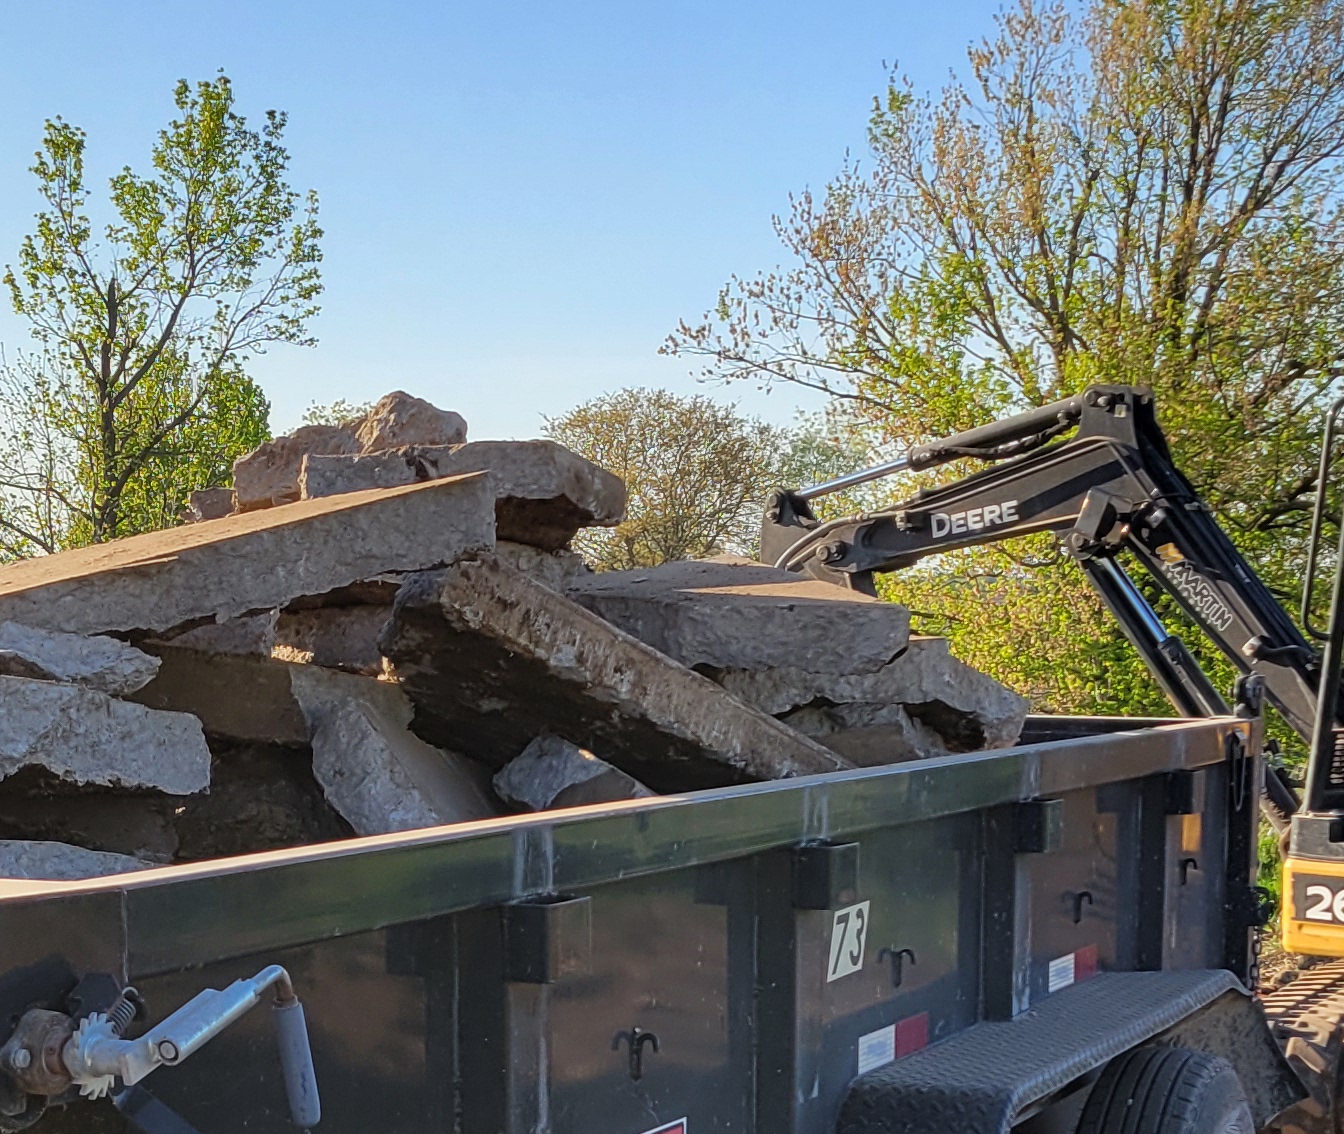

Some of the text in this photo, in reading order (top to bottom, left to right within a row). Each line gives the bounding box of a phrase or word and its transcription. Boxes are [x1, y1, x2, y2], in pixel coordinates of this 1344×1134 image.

[931, 500, 1019, 538] DEERE
[1169, 560, 1232, 631] MARTIN
[831, 908, 864, 975] 73
